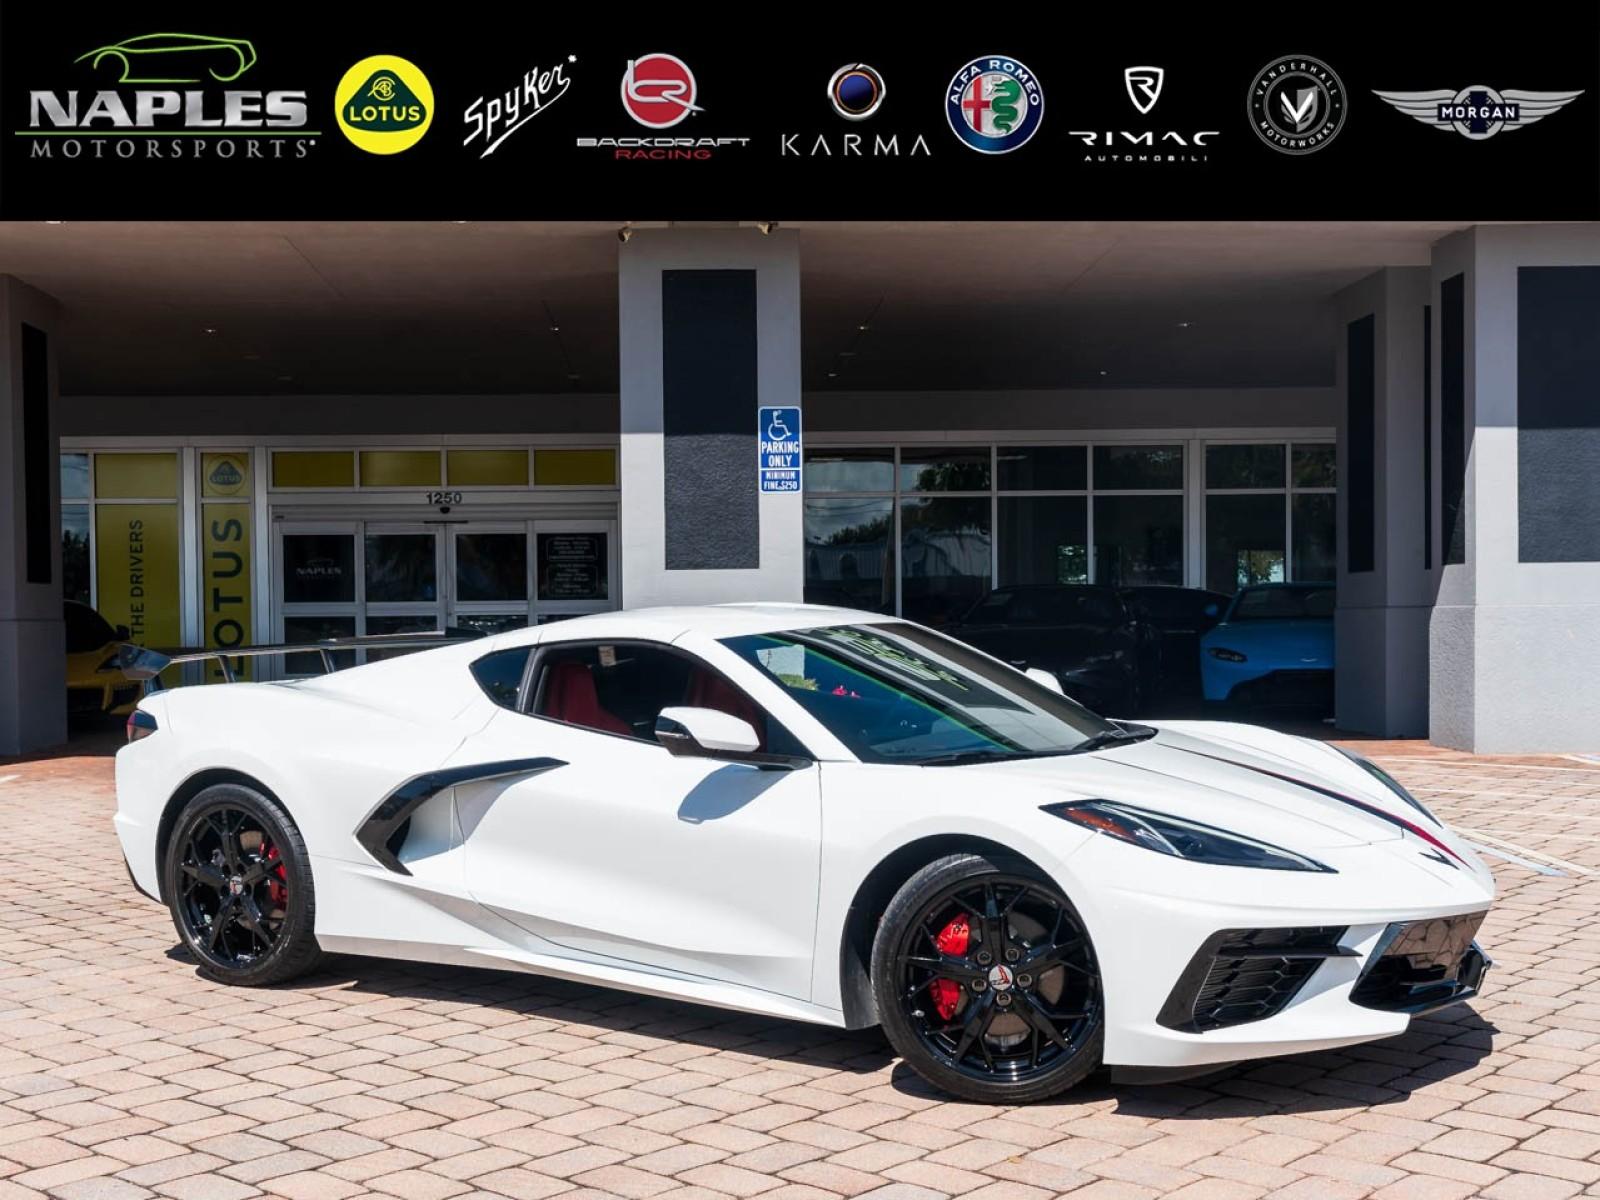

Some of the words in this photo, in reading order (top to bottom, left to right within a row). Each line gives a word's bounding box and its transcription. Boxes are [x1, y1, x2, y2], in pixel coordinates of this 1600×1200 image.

[761, 441, 799, 453] PARKING
[768, 455, 792, 467] ONLY
[766, 471, 795, 480] MINIMUM
[426, 491, 462, 505] 1250
[129, 520, 143, 597] DRIVERS
[212, 518, 244, 678] LOTUS
[131, 603, 144, 637] THE
